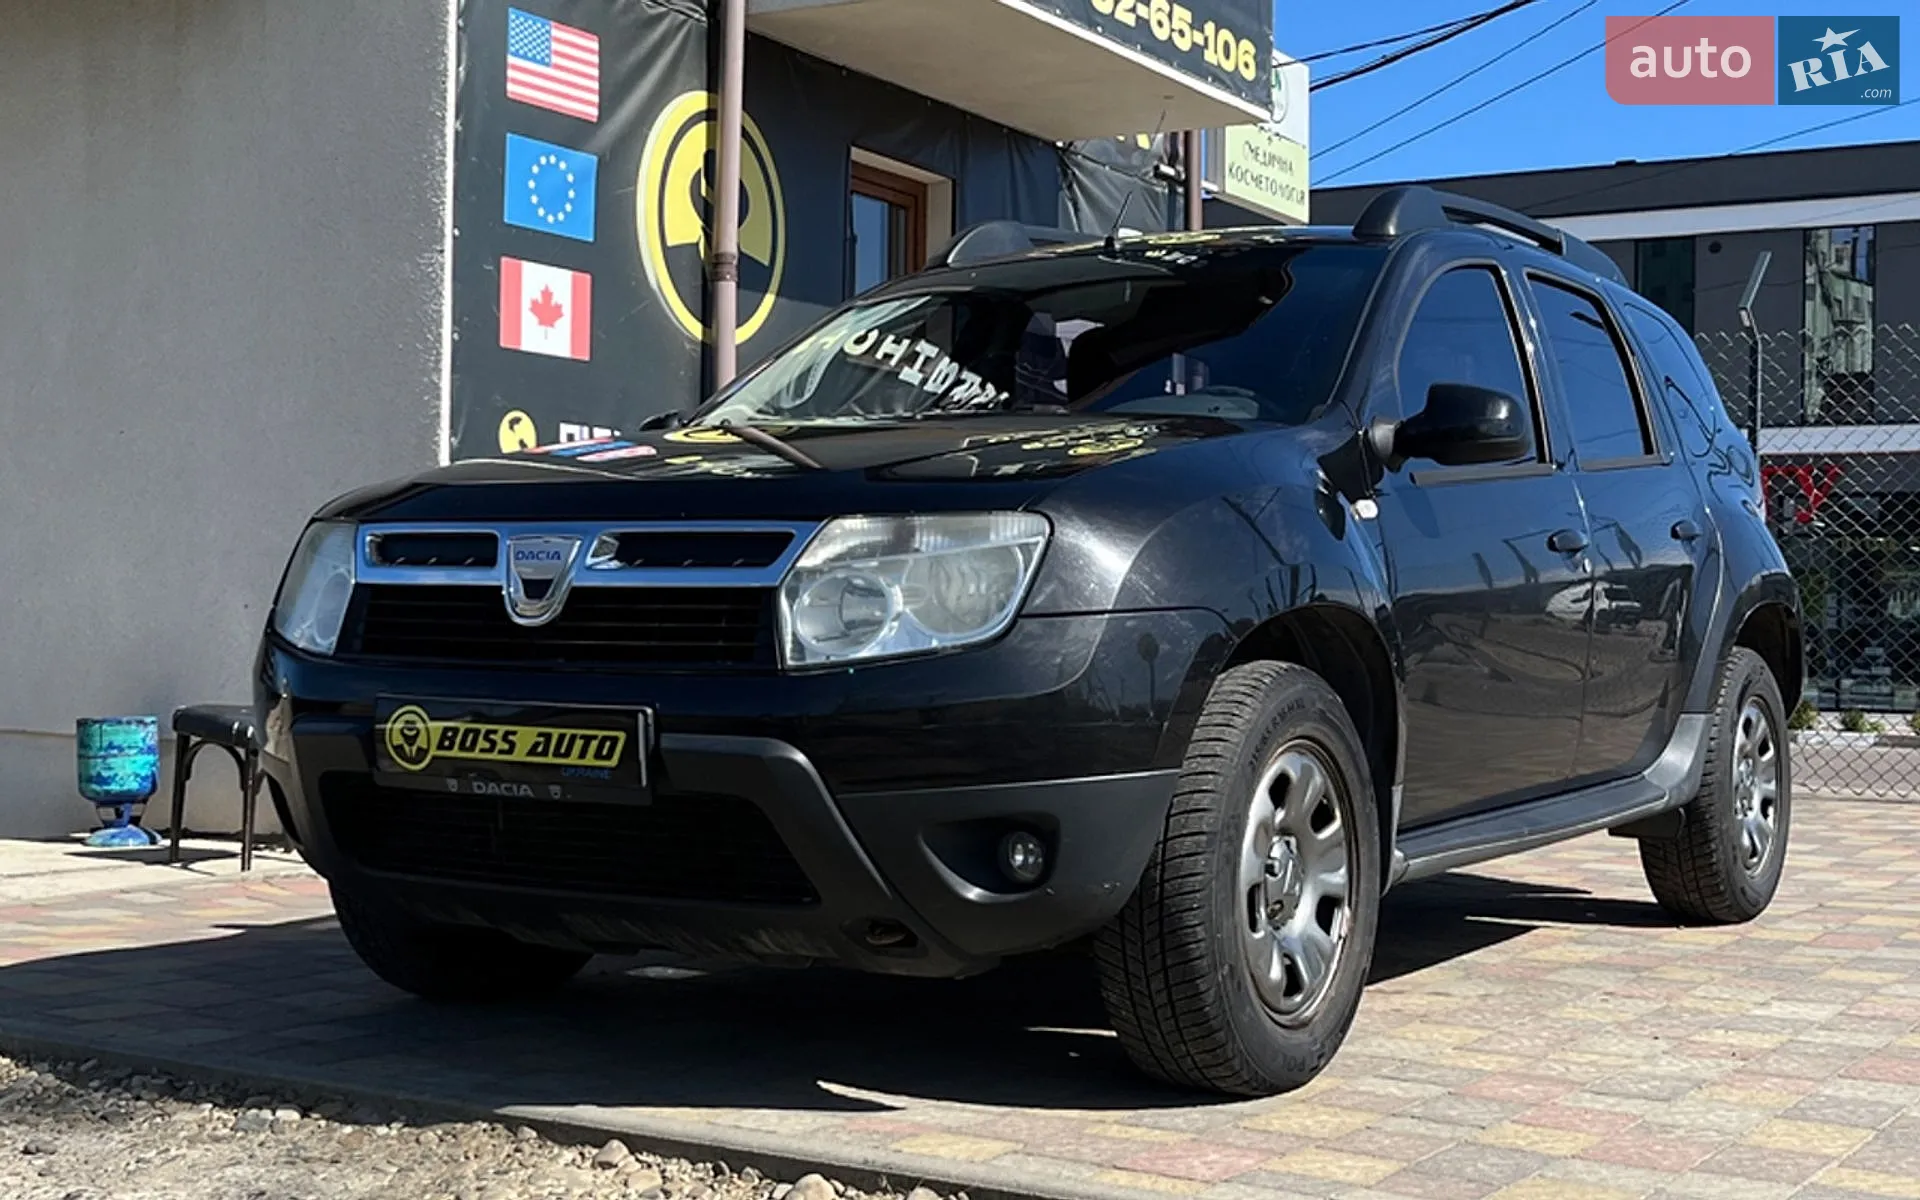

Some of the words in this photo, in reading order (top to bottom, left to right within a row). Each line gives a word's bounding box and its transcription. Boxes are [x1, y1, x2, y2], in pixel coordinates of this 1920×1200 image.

[515, 550, 562, 561] DACIA
[435, 726, 519, 756] BOSS
[526, 731, 621, 761] AUTO
[471, 780, 534, 798] DACIA
